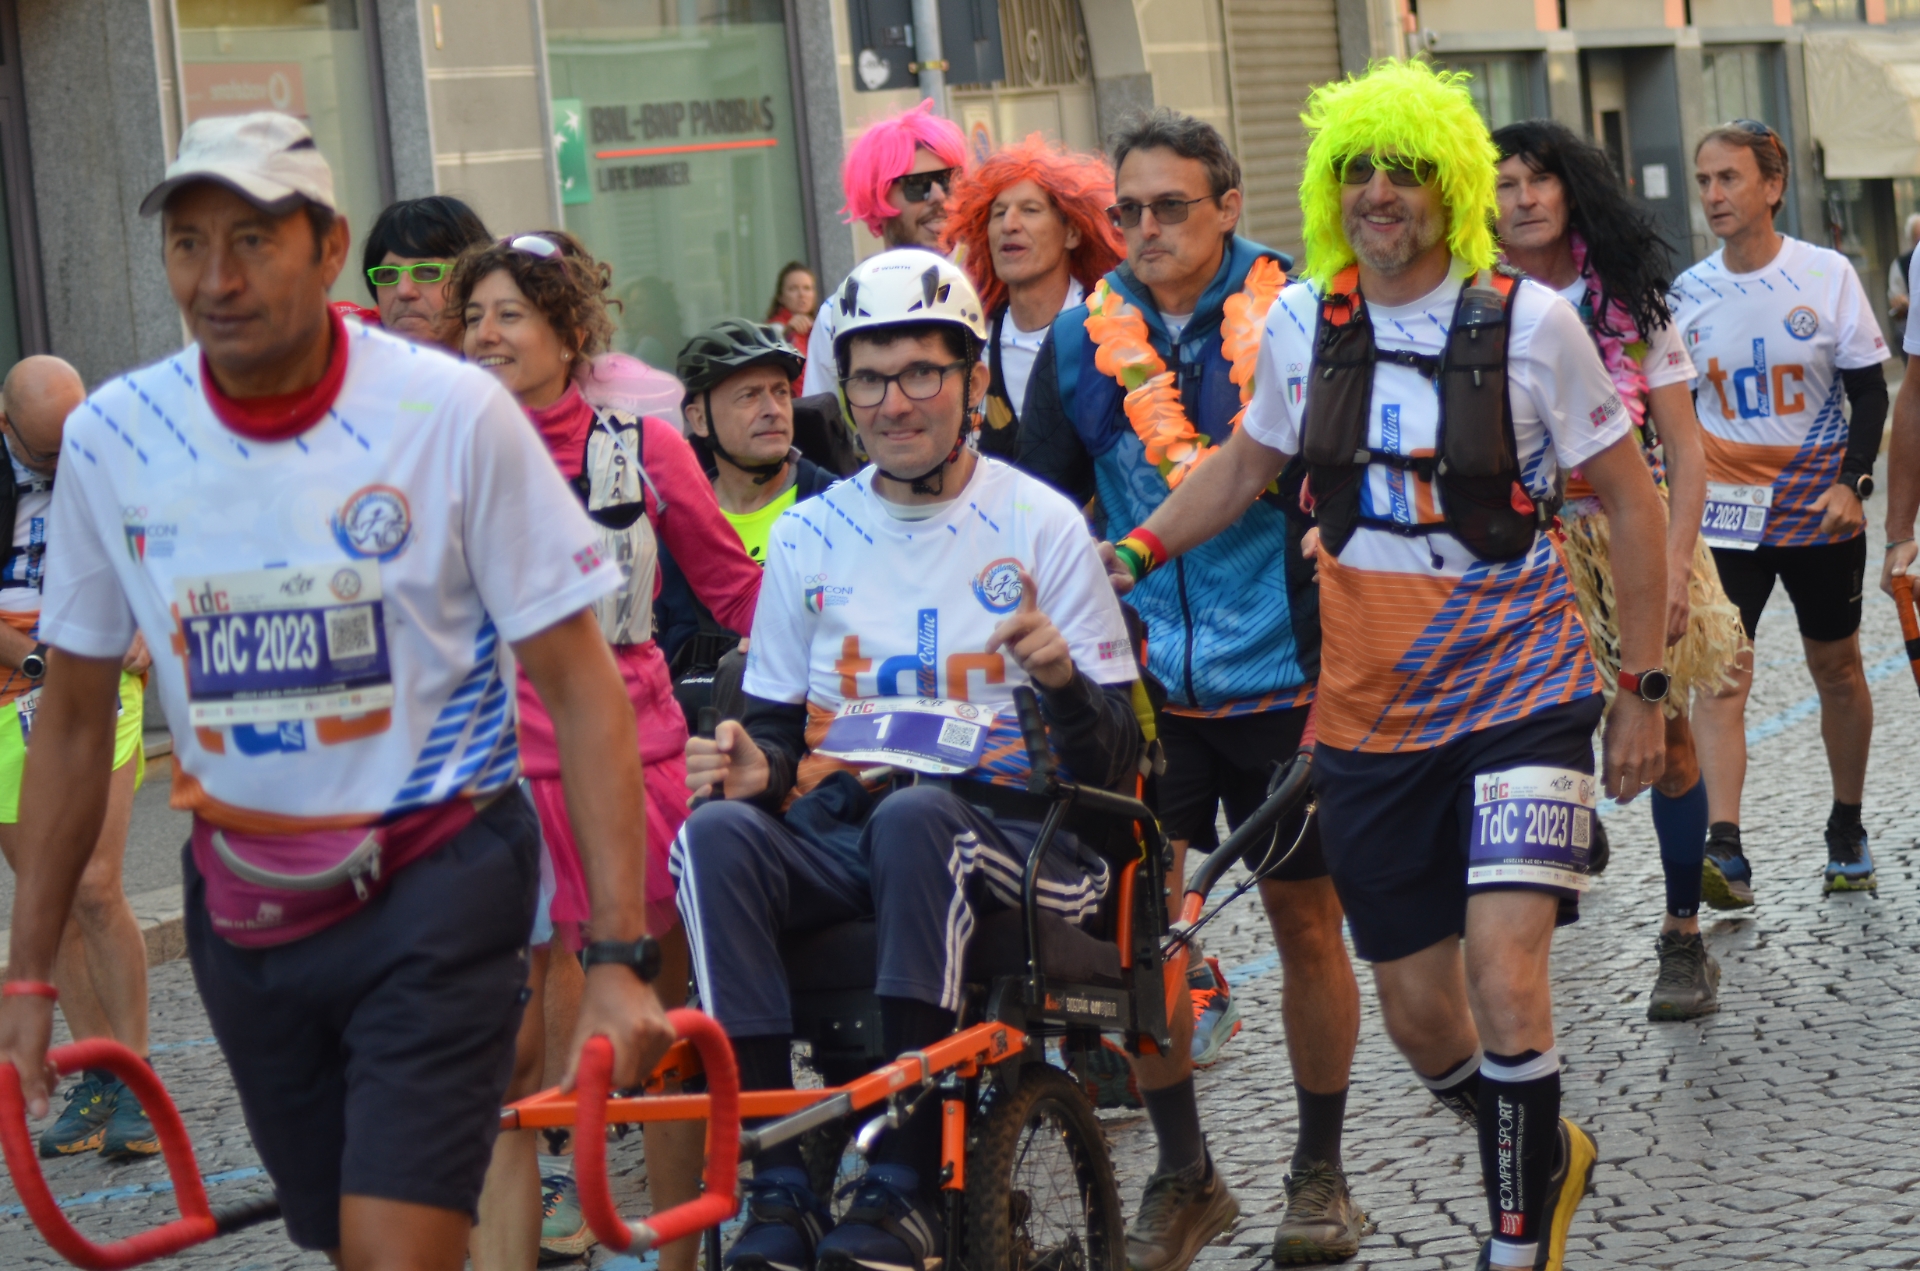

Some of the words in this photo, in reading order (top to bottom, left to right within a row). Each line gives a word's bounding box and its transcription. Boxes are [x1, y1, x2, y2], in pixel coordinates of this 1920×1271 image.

[1711, 504, 1743, 531] 2023
[187, 581, 230, 616] tdc
[825, 586, 853, 595] CONI
[190, 616, 248, 674] TdC
[254, 613, 319, 672] 2023
[918, 613, 935, 666] Colline
[844, 700, 875, 716] tdc
[872, 714, 893, 740] 1
[1482, 777, 1509, 802] tdc
[1479, 802, 1518, 846] TdC
[1524, 803, 1568, 848] 2023
